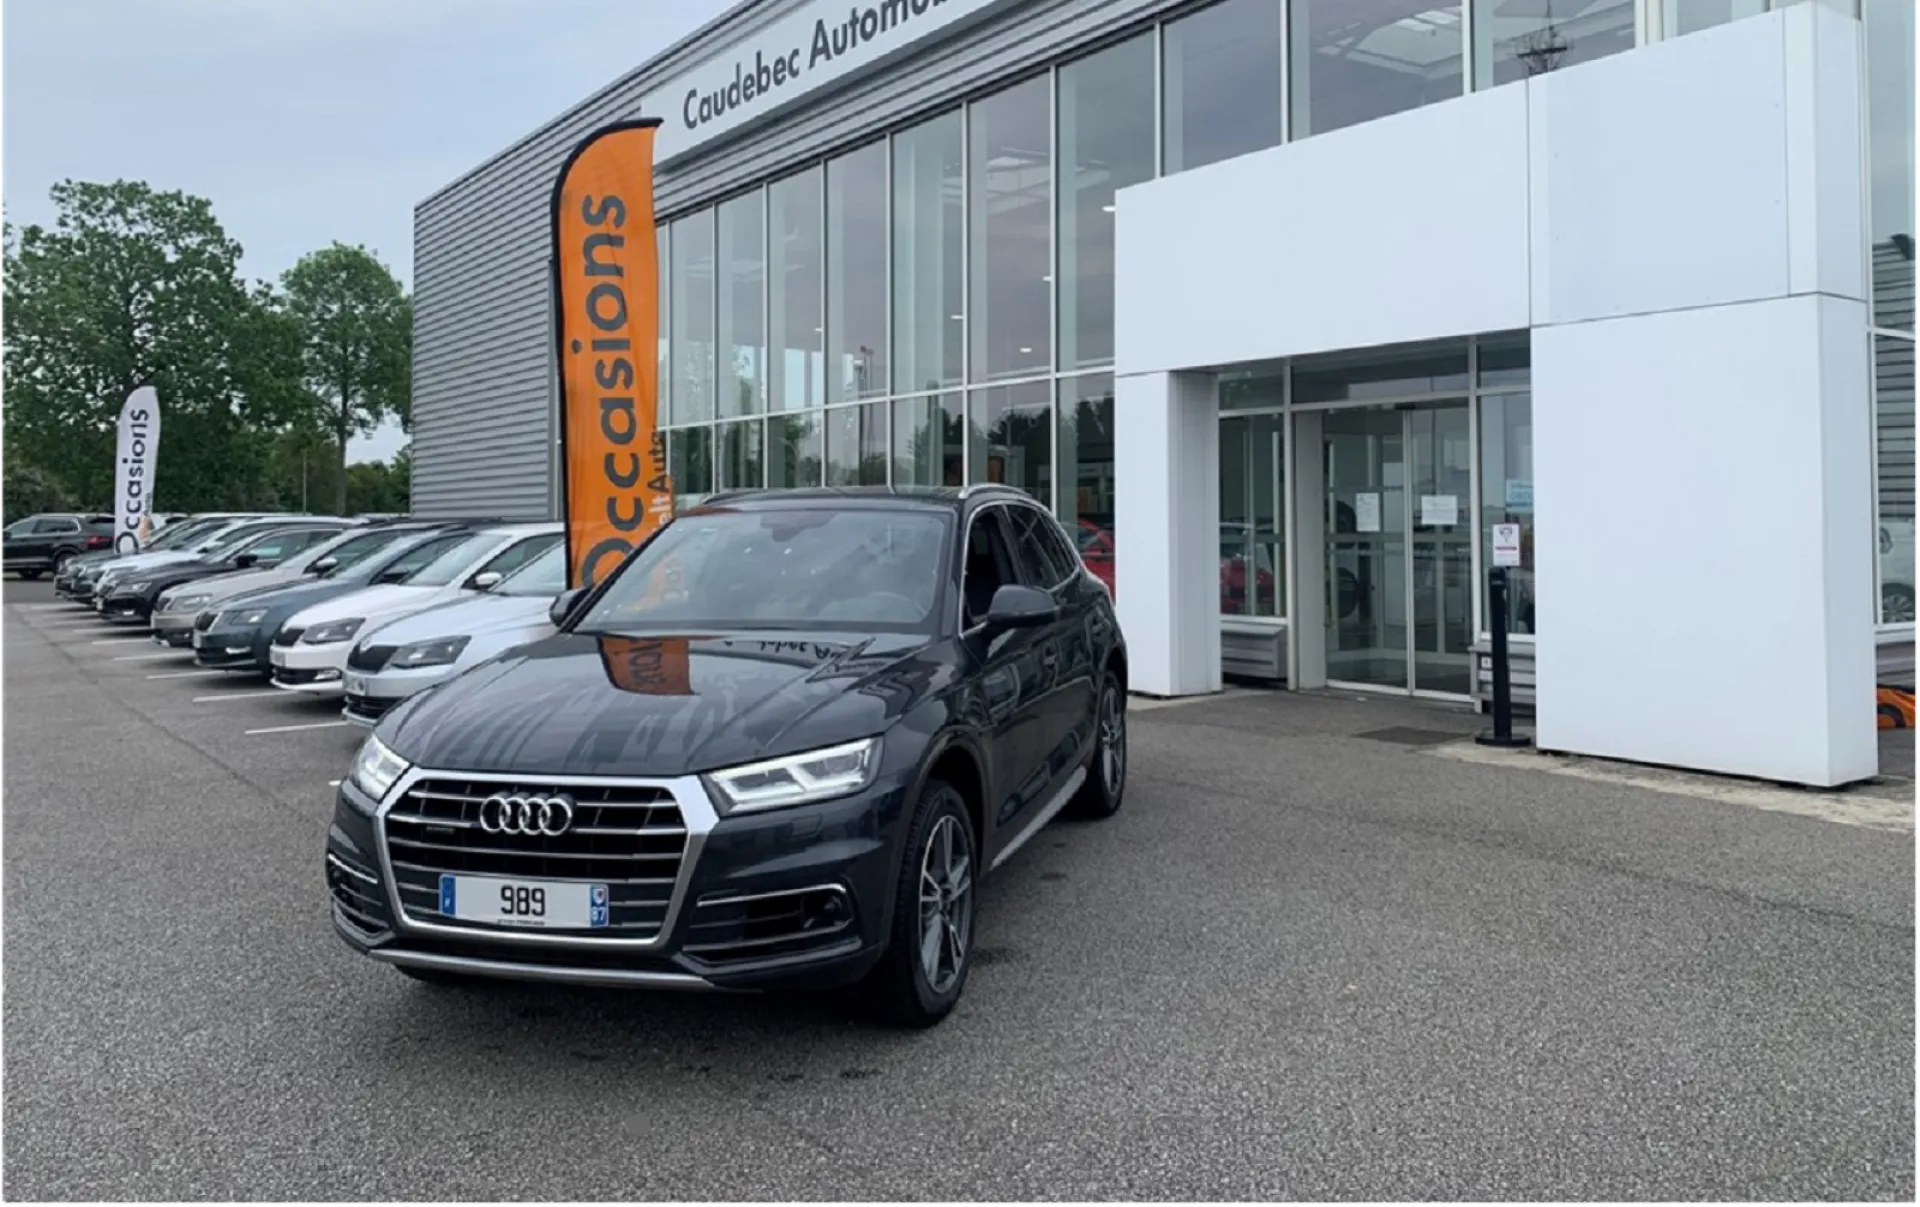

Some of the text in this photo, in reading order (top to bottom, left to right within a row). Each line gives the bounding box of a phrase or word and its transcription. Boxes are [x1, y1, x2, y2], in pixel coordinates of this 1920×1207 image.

[683, 0, 948, 129] Caudebec Automo
[115, 409, 149, 553] Occasions
[500, 885, 545, 916] 989
